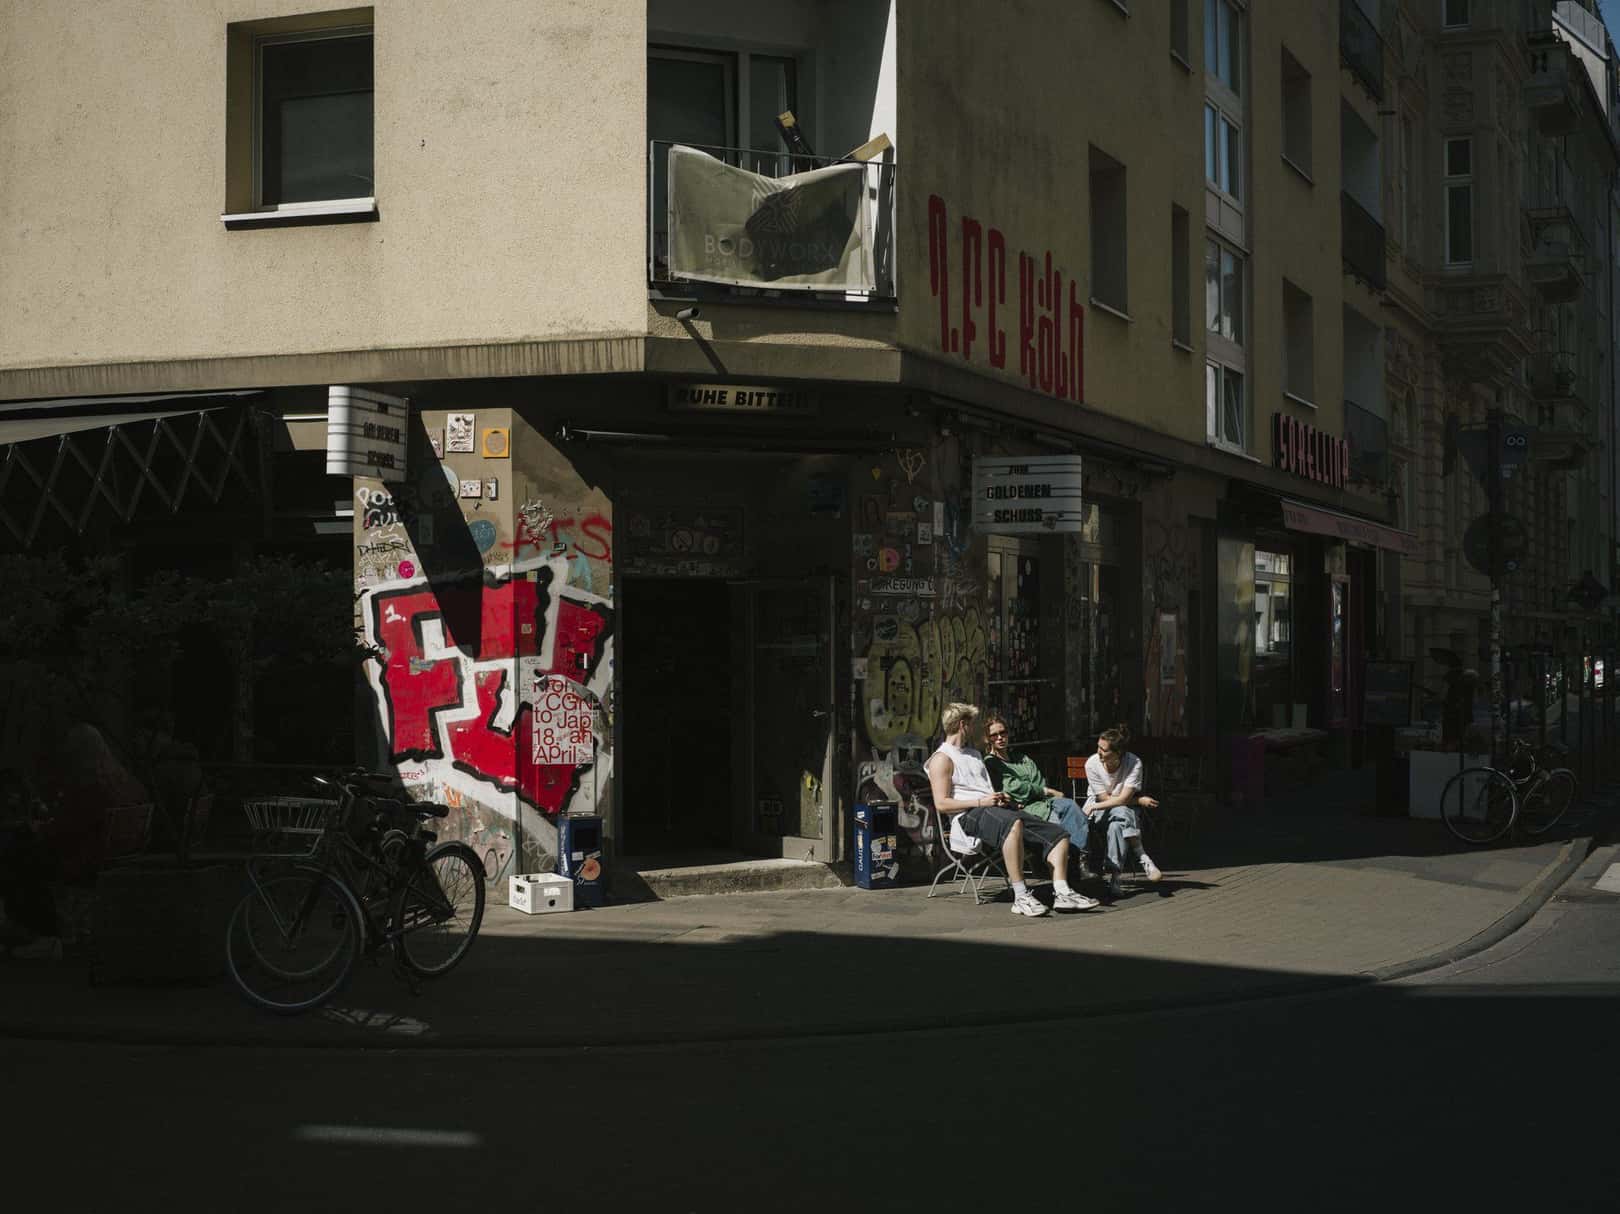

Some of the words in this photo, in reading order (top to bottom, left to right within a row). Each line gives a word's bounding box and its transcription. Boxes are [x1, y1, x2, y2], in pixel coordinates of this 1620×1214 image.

[678, 389, 728, 406] RUHE
[986, 484, 1052, 499] GOLDENEN
[994, 508, 1043, 523] SCHUSS
[545, 693, 593, 711] CGN
[534, 706, 553, 723] to
[556, 711, 592, 732] Jap
[533, 728, 560, 746] 18.
[570, 729, 593, 744] an
[533, 745, 577, 763] April
